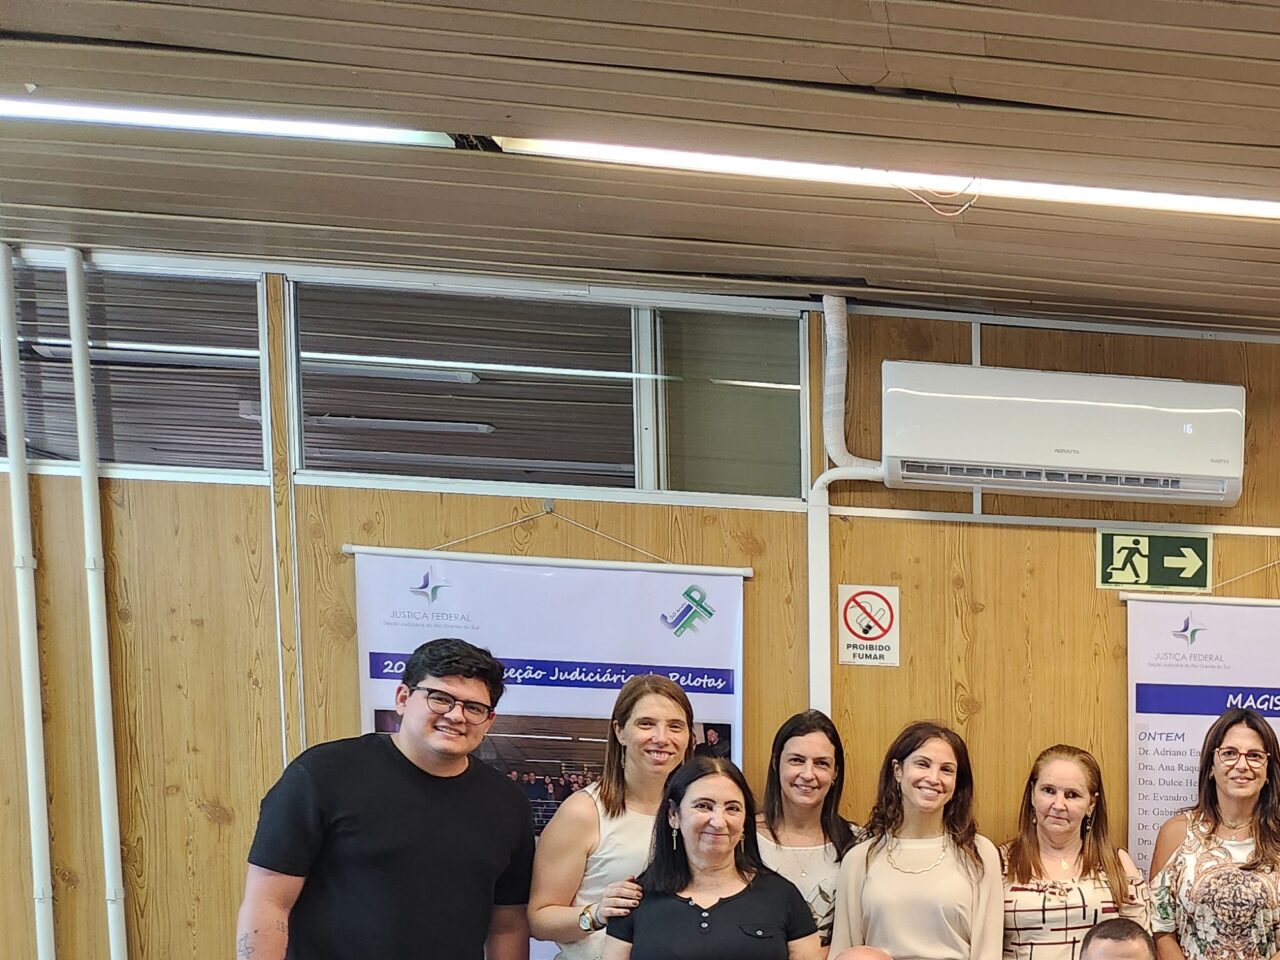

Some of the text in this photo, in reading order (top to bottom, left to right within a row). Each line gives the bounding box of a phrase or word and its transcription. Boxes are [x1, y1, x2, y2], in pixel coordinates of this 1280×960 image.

[1183, 423, 1193, 434] 16
[390, 610, 471, 622] JUSTIÇA FEDERAL
[846, 643, 891, 651] PROIBIDO
[852, 652, 885, 660] FUMAR
[1155, 652, 1224, 662] JUSTIÇA FEDERAL
[382, 660, 406, 673] 20
[669, 672, 727, 689] Pelotas
[1138, 731, 1186, 742] ONTEM
[1138, 747, 1150, 756] Dr.
[1153, 747, 1188, 757] Adriano
[1138, 762, 1155, 771] Dra.
[1157, 763, 1175, 771] Ana
[1138, 777, 1155, 786] Dra.
[1158, 777, 1183, 787] Dulce
[1138, 793, 1150, 801] Dr.
[1153, 793, 1188, 802] Evandro
[1138, 808, 1149, 816] Dr.
[1137, 822, 1149, 831] Dr.
[1137, 838, 1154, 846] Dra.
[1137, 852, 1149, 860] Dr.
